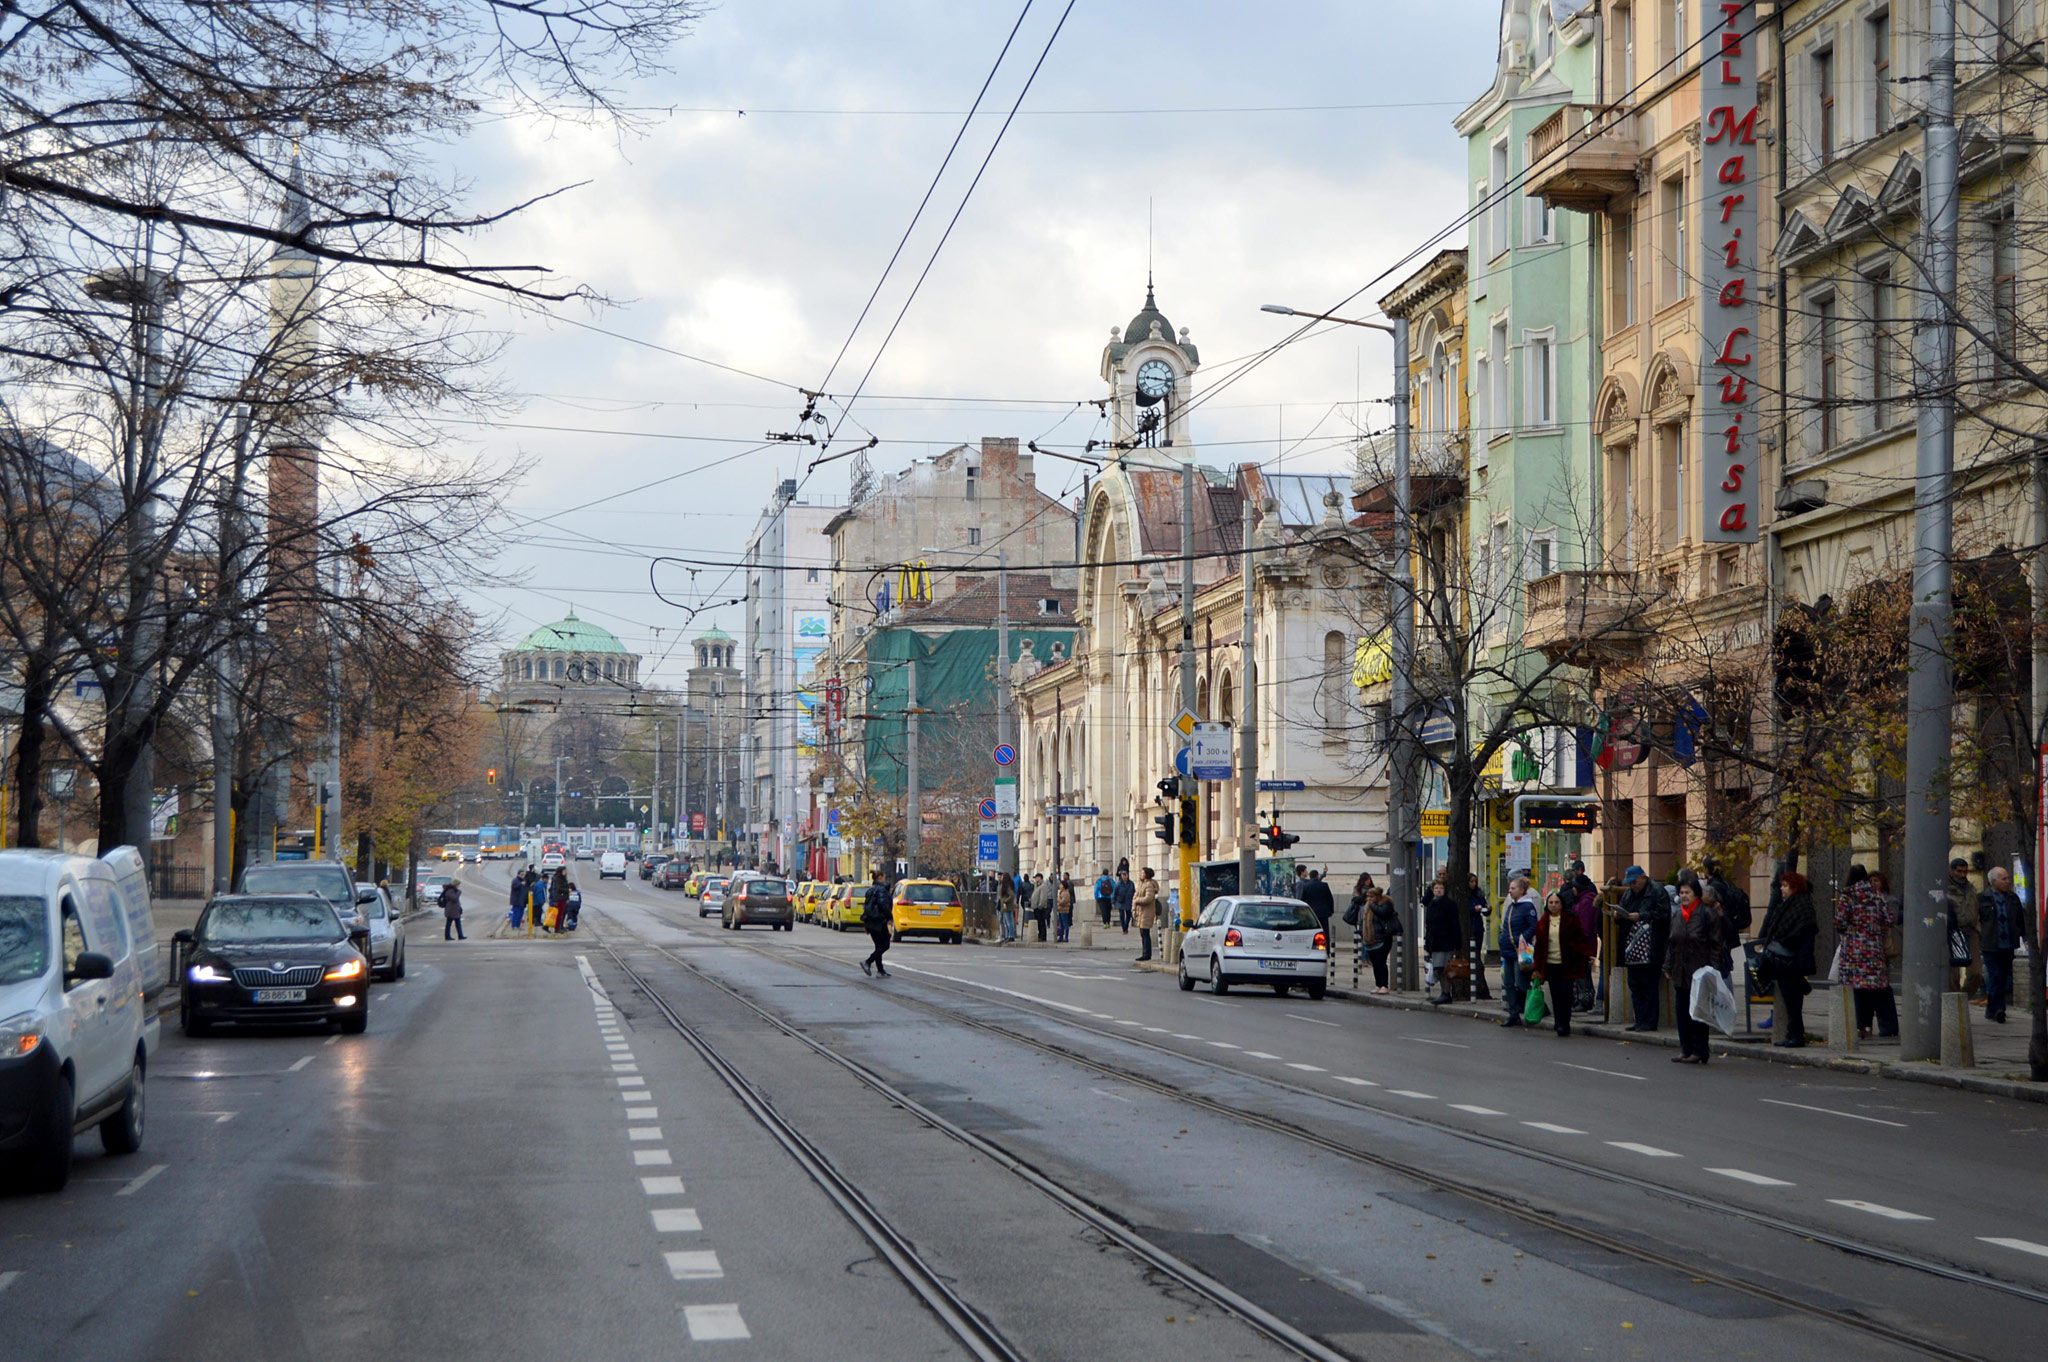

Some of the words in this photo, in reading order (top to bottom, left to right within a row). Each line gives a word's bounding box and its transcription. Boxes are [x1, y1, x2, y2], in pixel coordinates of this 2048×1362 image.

[1704, 105, 1757, 307] Maria
[1714, 327, 1752, 532] Luisa
[897, 560, 932, 604] M
[1206, 748, 1220, 756] 300
